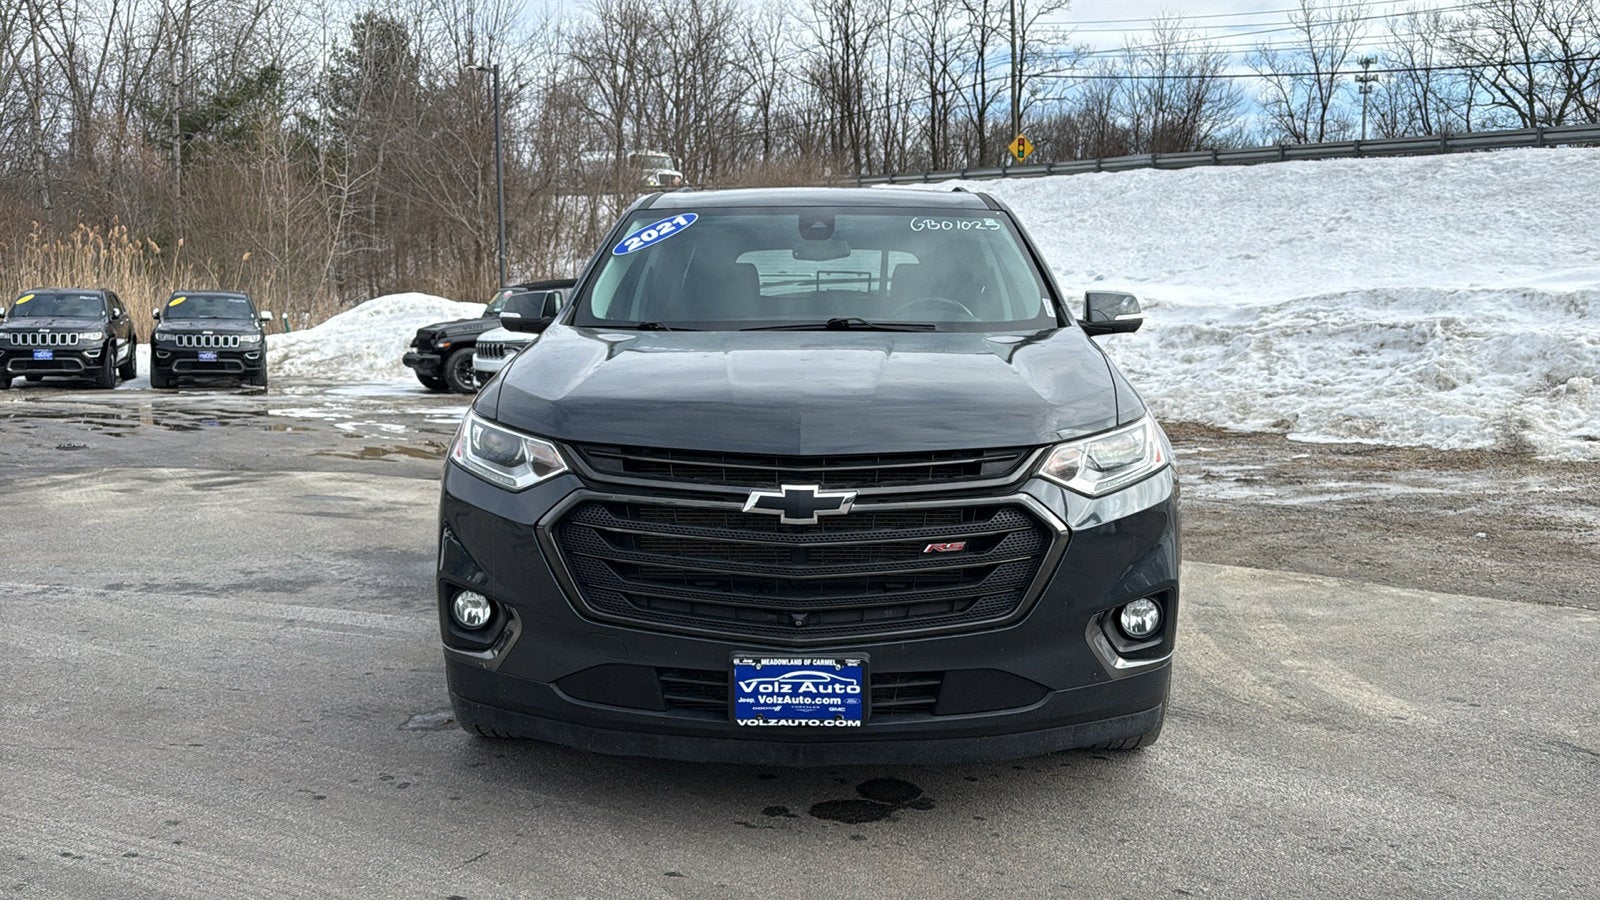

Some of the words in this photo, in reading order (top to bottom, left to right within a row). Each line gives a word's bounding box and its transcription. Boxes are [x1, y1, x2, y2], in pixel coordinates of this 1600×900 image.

[624, 215, 688, 252] 2021
[923, 541, 966, 553] RS
[760, 658, 802, 666] MEADOWLAND
[803, 658, 811, 666] OF
[812, 658, 837, 666] CARMEL
[738, 681, 792, 693] Volz
[797, 681, 861, 694] Auto
[757, 694, 842, 705] VolzAuto.com
[736, 719, 861, 727] VOLZAUTO.COM
